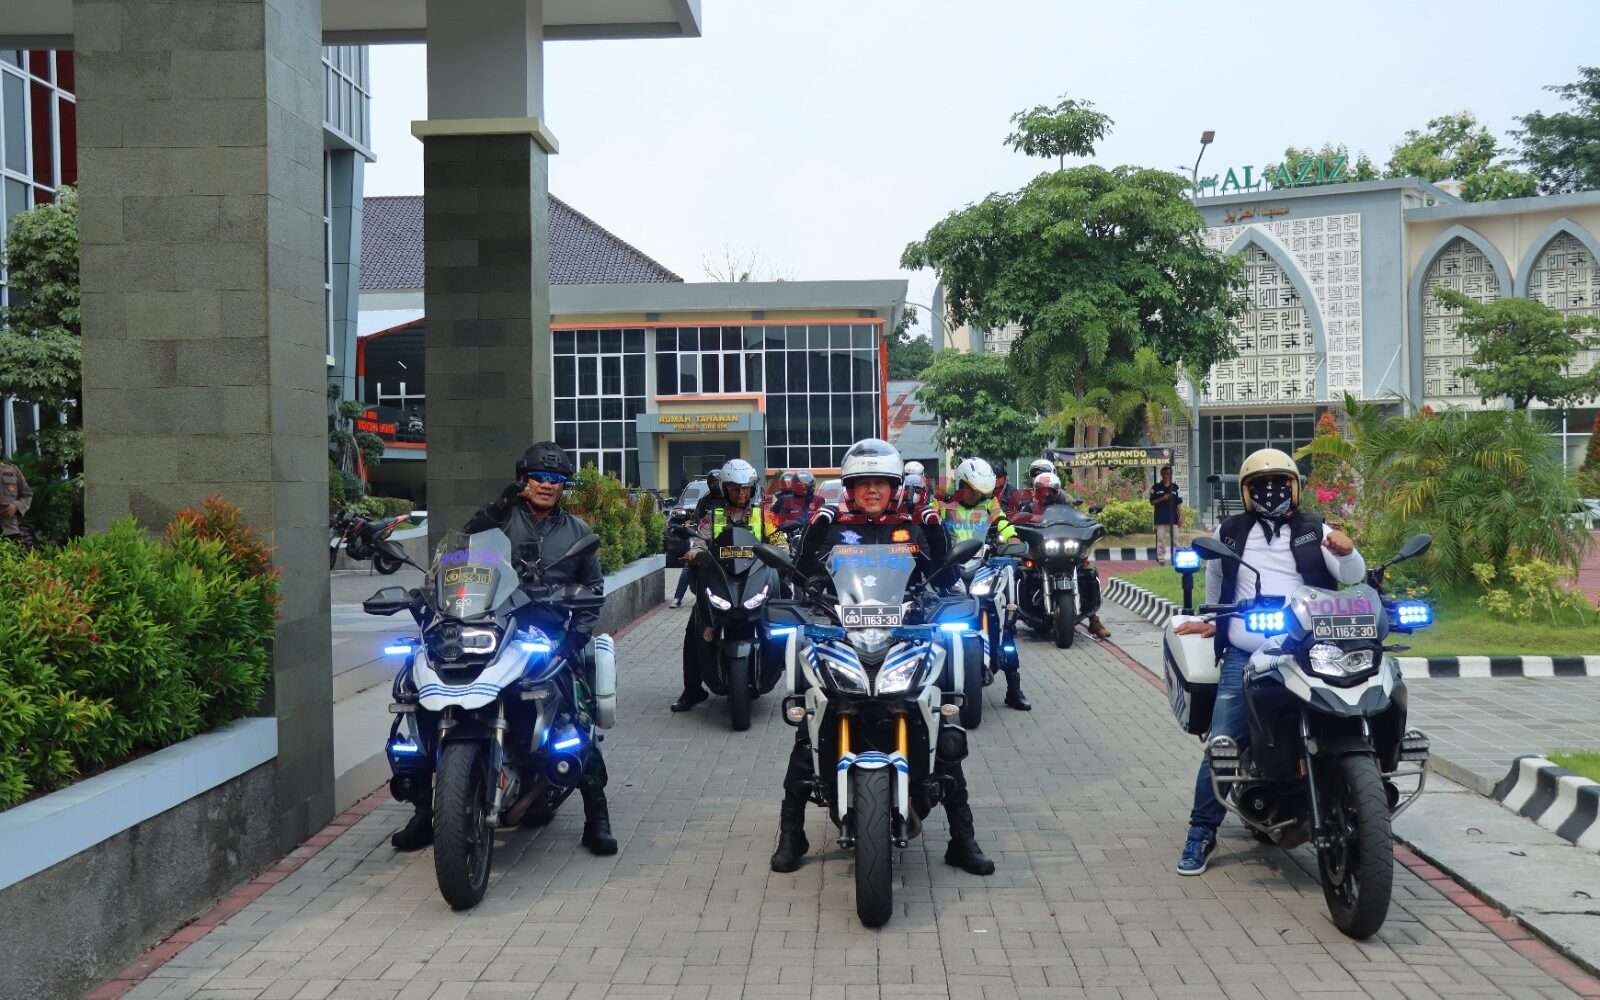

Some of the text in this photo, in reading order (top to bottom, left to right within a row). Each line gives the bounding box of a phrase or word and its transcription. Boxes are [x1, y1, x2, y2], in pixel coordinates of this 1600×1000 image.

[658, 415, 690, 424] RUMAH
[1097, 449, 1147, 459] KOMANDO
[1107, 458, 1139, 466] POLRES
[1305, 597, 1373, 615] POLISI
[863, 616, 898, 625] 1163-30
[1335, 627, 1373, 637] 1162-30
